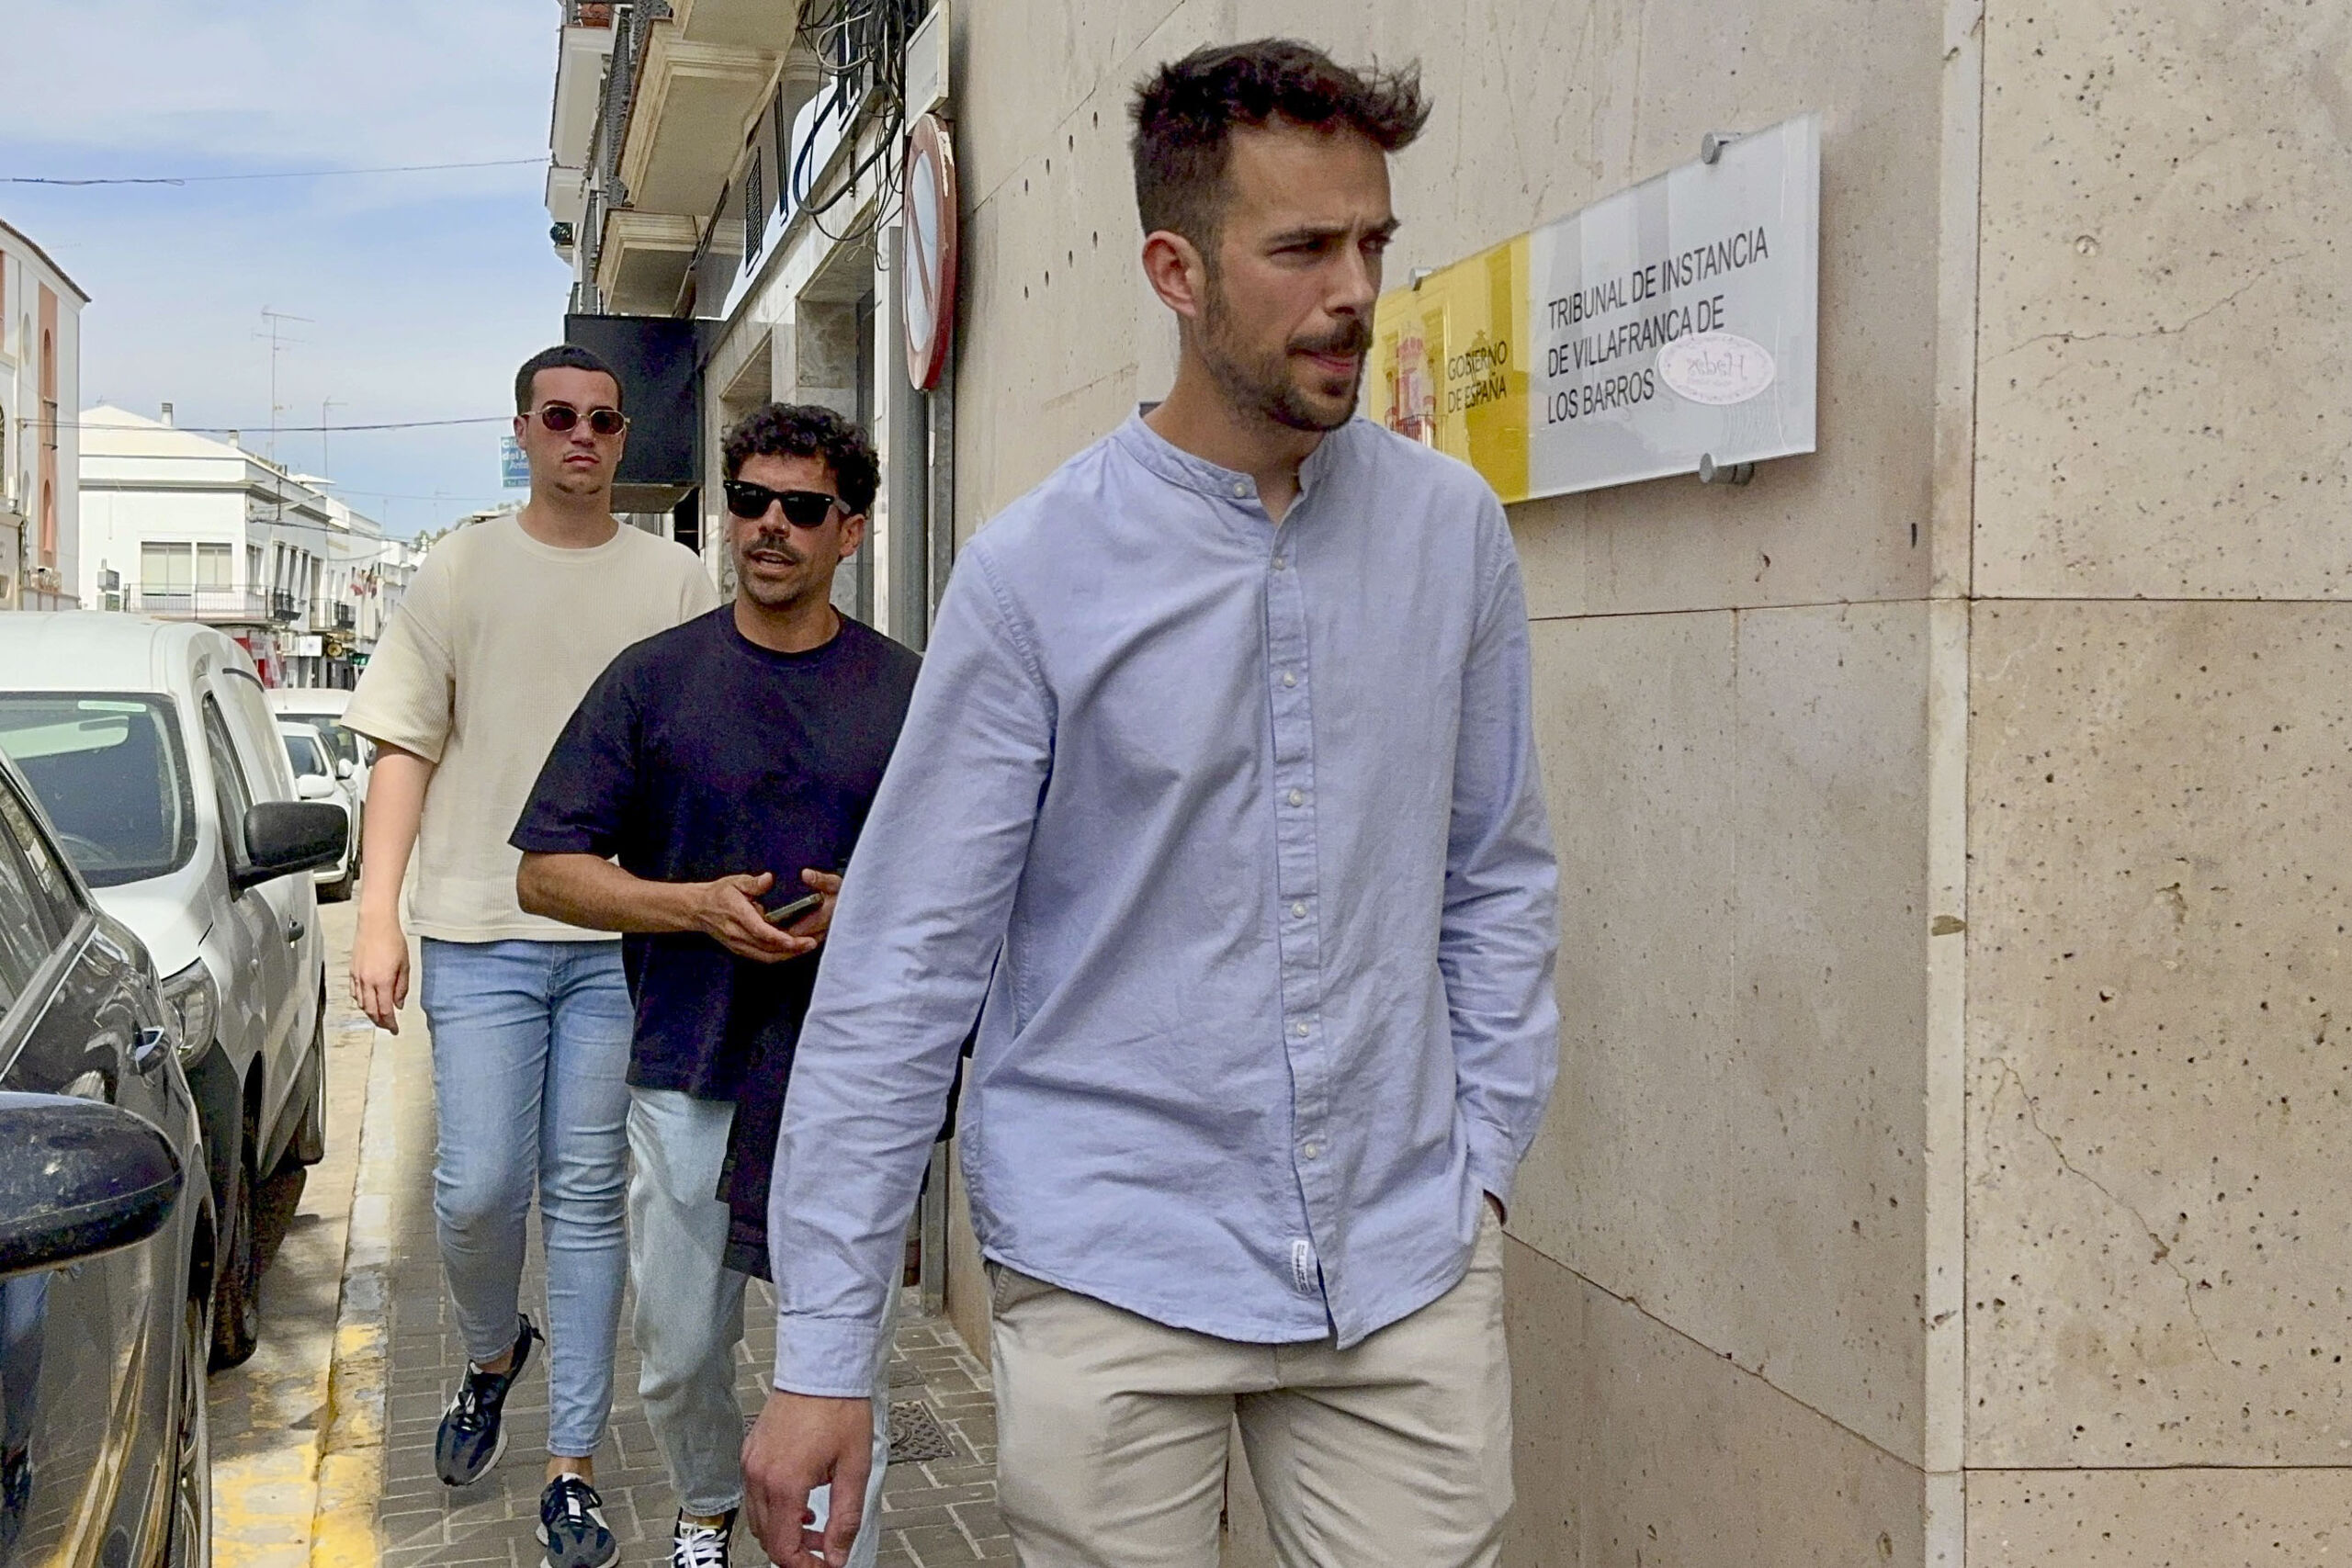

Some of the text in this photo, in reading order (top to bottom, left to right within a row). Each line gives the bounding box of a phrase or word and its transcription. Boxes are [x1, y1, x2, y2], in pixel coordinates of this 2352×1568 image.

[1548, 226, 1769, 331] TRIBUNAL DE INSTANCIA
[1448, 341, 1507, 381] GOBIERNO
[1548, 294, 1724, 378] DE VILLAFRANCA DE
[1448, 370, 1508, 414] DE ESPAÑA
[1548, 389, 1578, 424] LOS
[1583, 367, 1655, 415] BARROS
